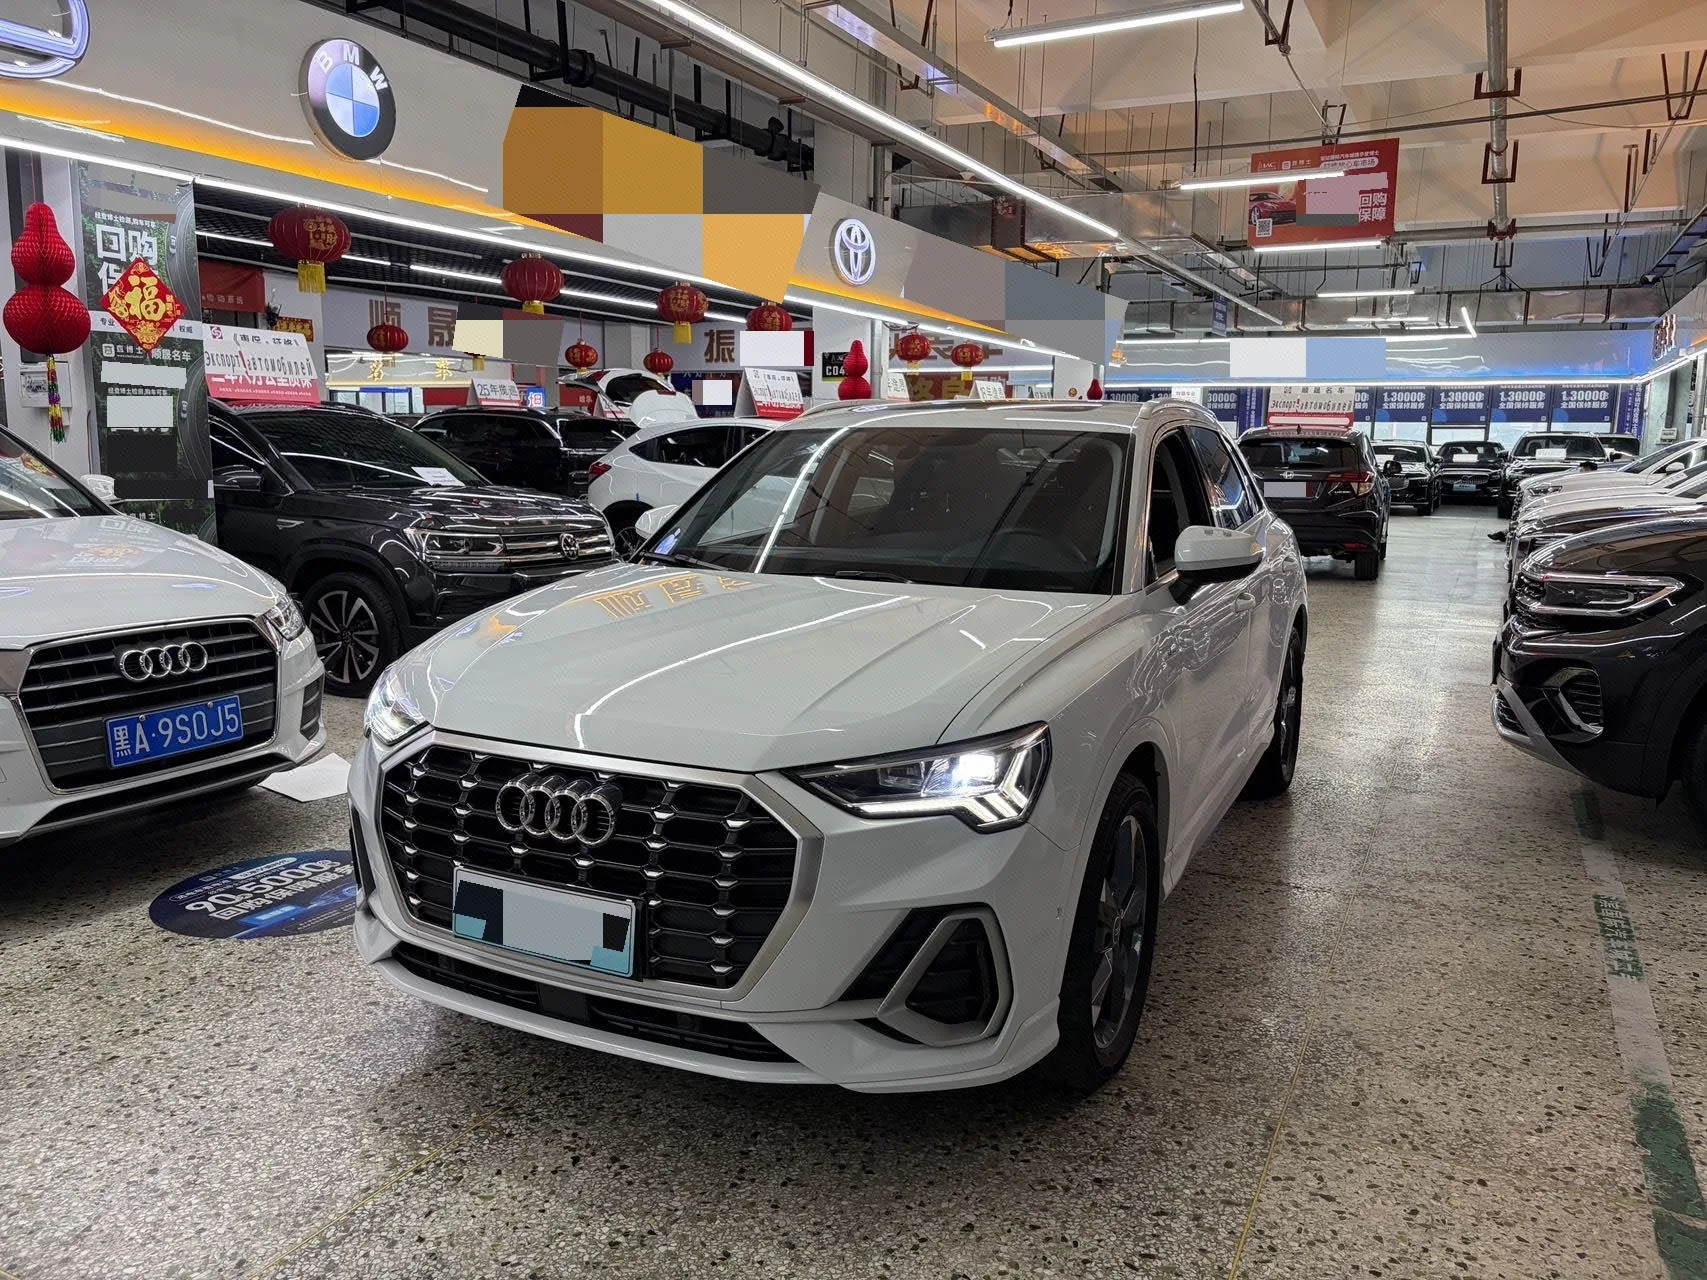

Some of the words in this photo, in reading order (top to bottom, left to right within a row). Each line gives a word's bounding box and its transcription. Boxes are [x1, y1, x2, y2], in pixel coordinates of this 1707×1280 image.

[317, 44, 388, 91] BMW
[1359, 192, 1388, 207] 回购
[1359, 206, 1387, 222] 保障
[95, 223, 158, 265] 回购
[703, 329, 736, 363] 振
